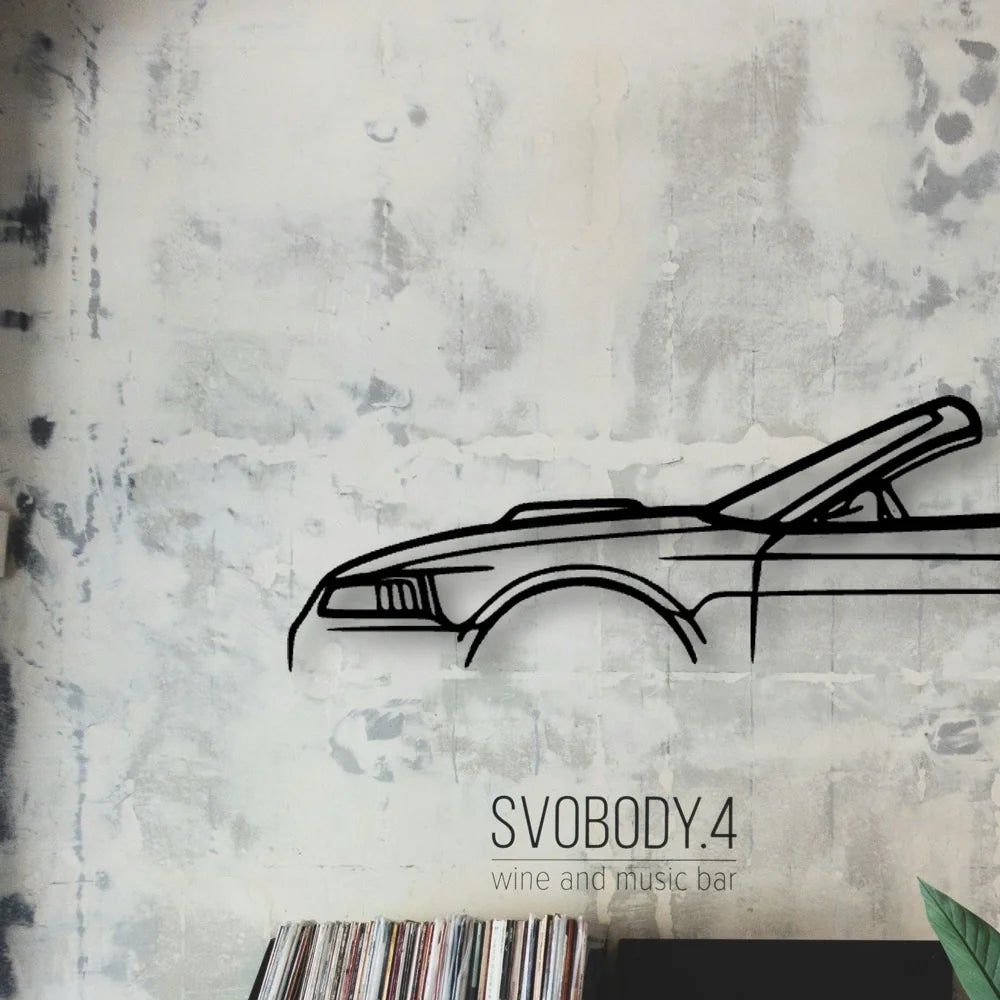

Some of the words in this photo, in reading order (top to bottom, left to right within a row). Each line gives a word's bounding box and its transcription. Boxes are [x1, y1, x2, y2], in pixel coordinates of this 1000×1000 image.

[491, 795, 738, 849] SVOBODY.4
[491, 866, 551, 891] wine
[560, 866, 606, 891] and
[616, 866, 688, 891] music
[697, 865, 737, 891] bar
